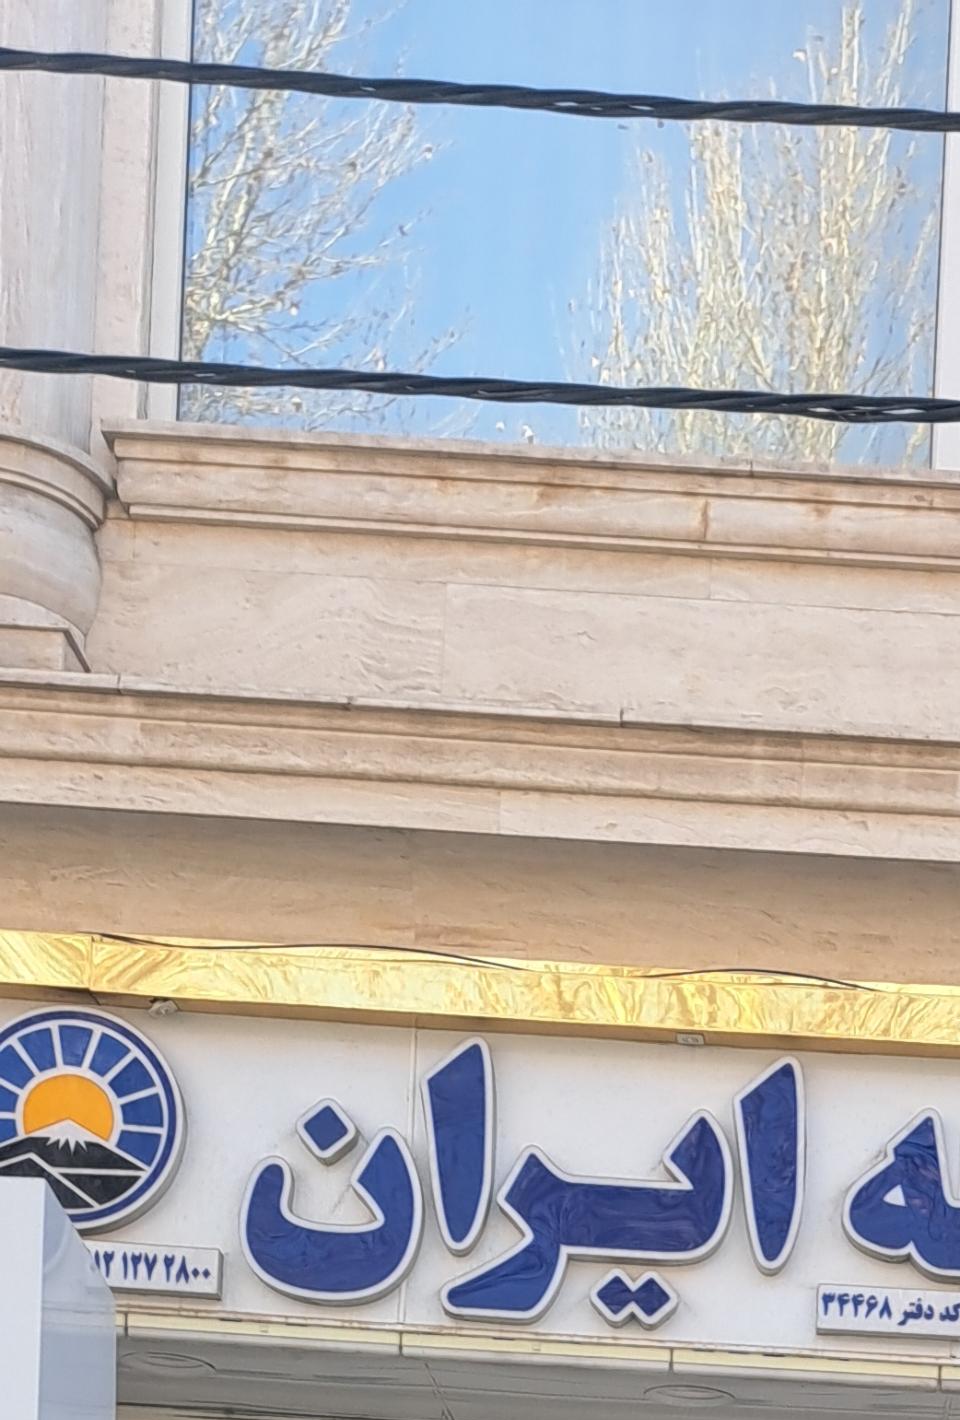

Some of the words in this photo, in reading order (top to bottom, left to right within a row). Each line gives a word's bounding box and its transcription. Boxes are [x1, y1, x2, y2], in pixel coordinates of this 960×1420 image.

[244, 1039, 801, 1322] ایران
[163, 1254, 212, 1284] ۲۸۰۰
[821, 1291, 893, 1320] ۳۴۴۶۸
[897, 1296, 935, 1326] دفتر
